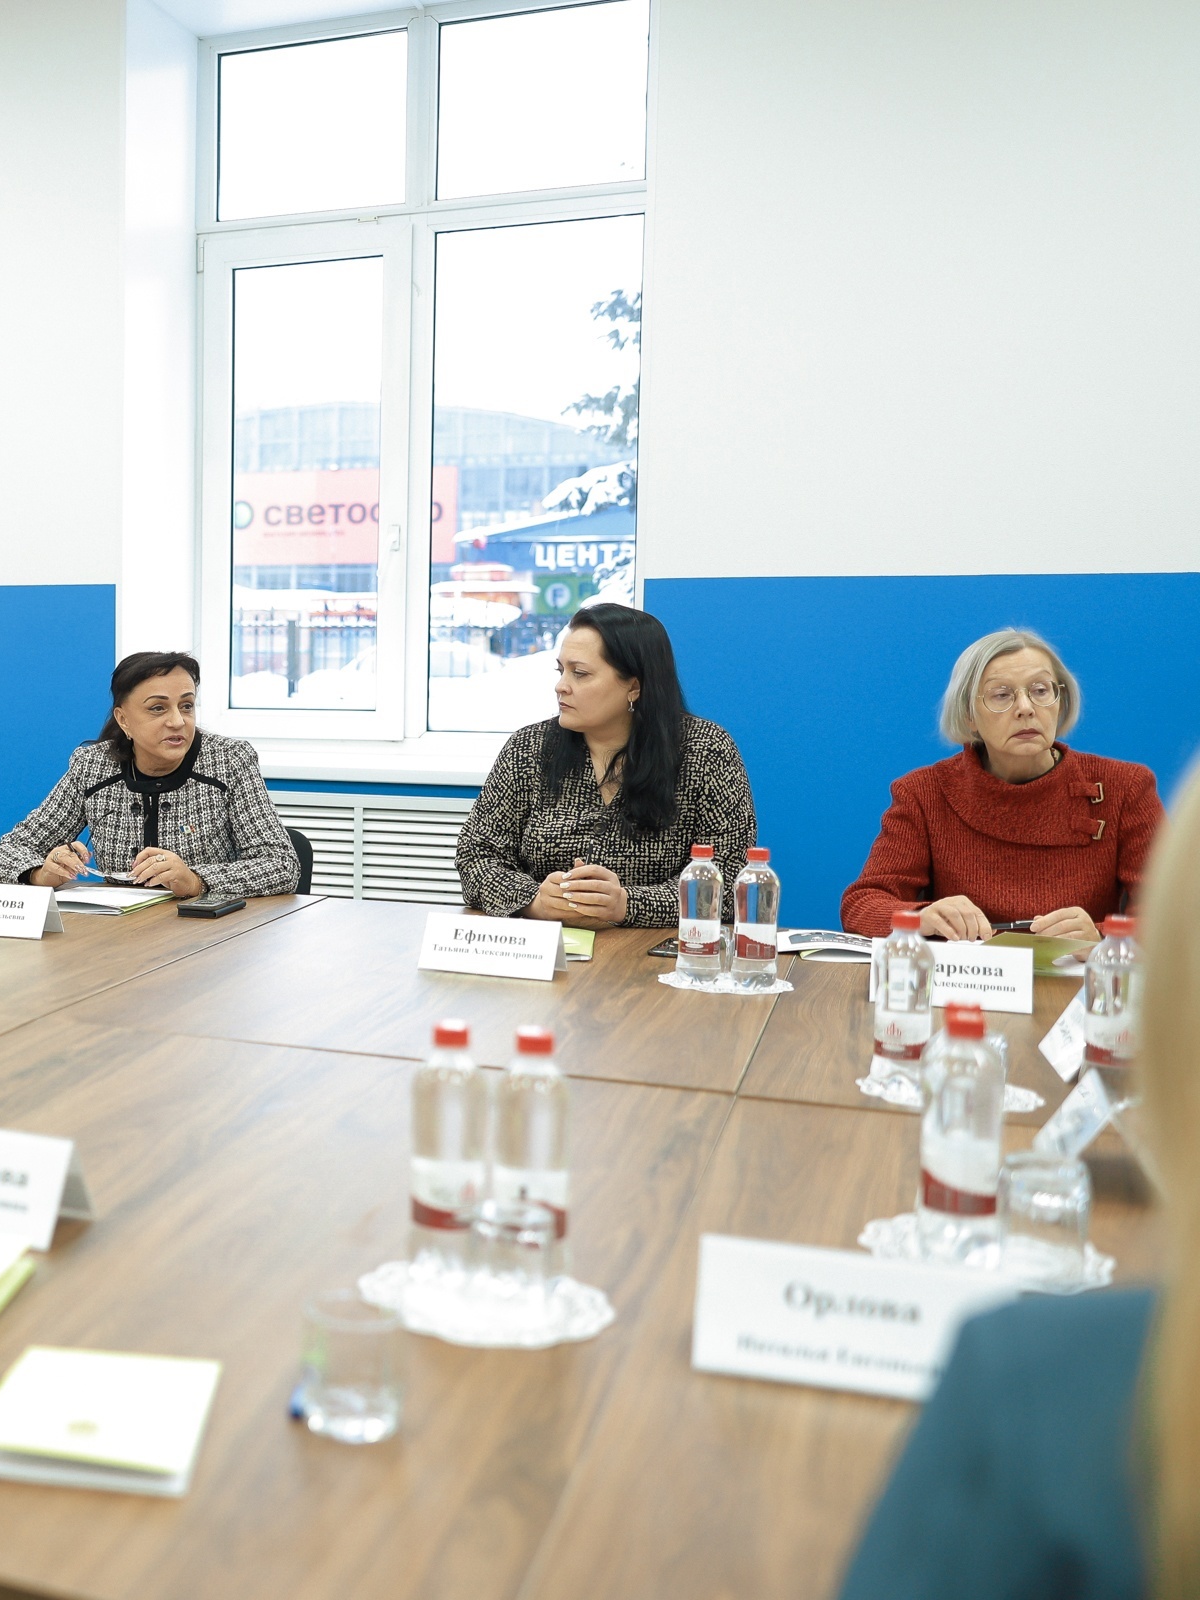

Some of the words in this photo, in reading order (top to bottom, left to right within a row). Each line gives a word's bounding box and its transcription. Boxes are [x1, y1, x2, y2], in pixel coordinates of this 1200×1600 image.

[264, 502, 443, 526] свето
[453, 928, 527, 946] Ефимова
[433, 944, 469, 954] Татьяна
[472, 947, 543, 960] Александровна
[935, 963, 1004, 977] аркова
[783, 1280, 922, 1324] Орлова
